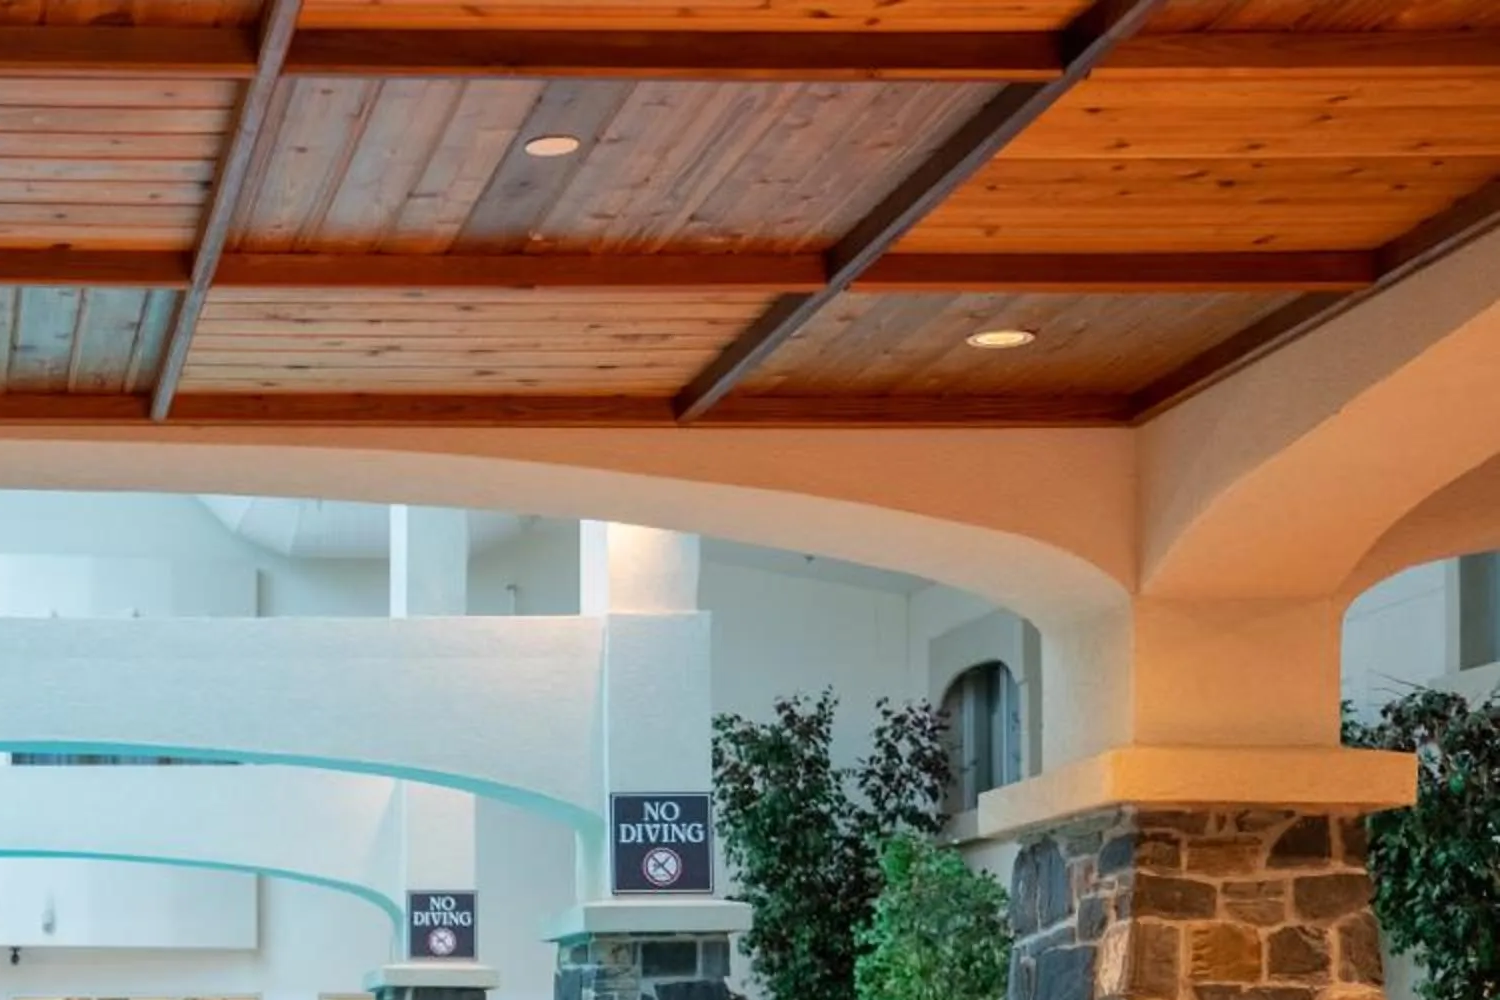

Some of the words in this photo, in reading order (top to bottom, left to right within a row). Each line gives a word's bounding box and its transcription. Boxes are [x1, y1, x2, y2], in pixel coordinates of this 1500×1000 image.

[643, 801, 680, 821] NO
[619, 823, 705, 843] DIVING
[429, 896, 456, 911] NO
[413, 911, 471, 926] DIVING
